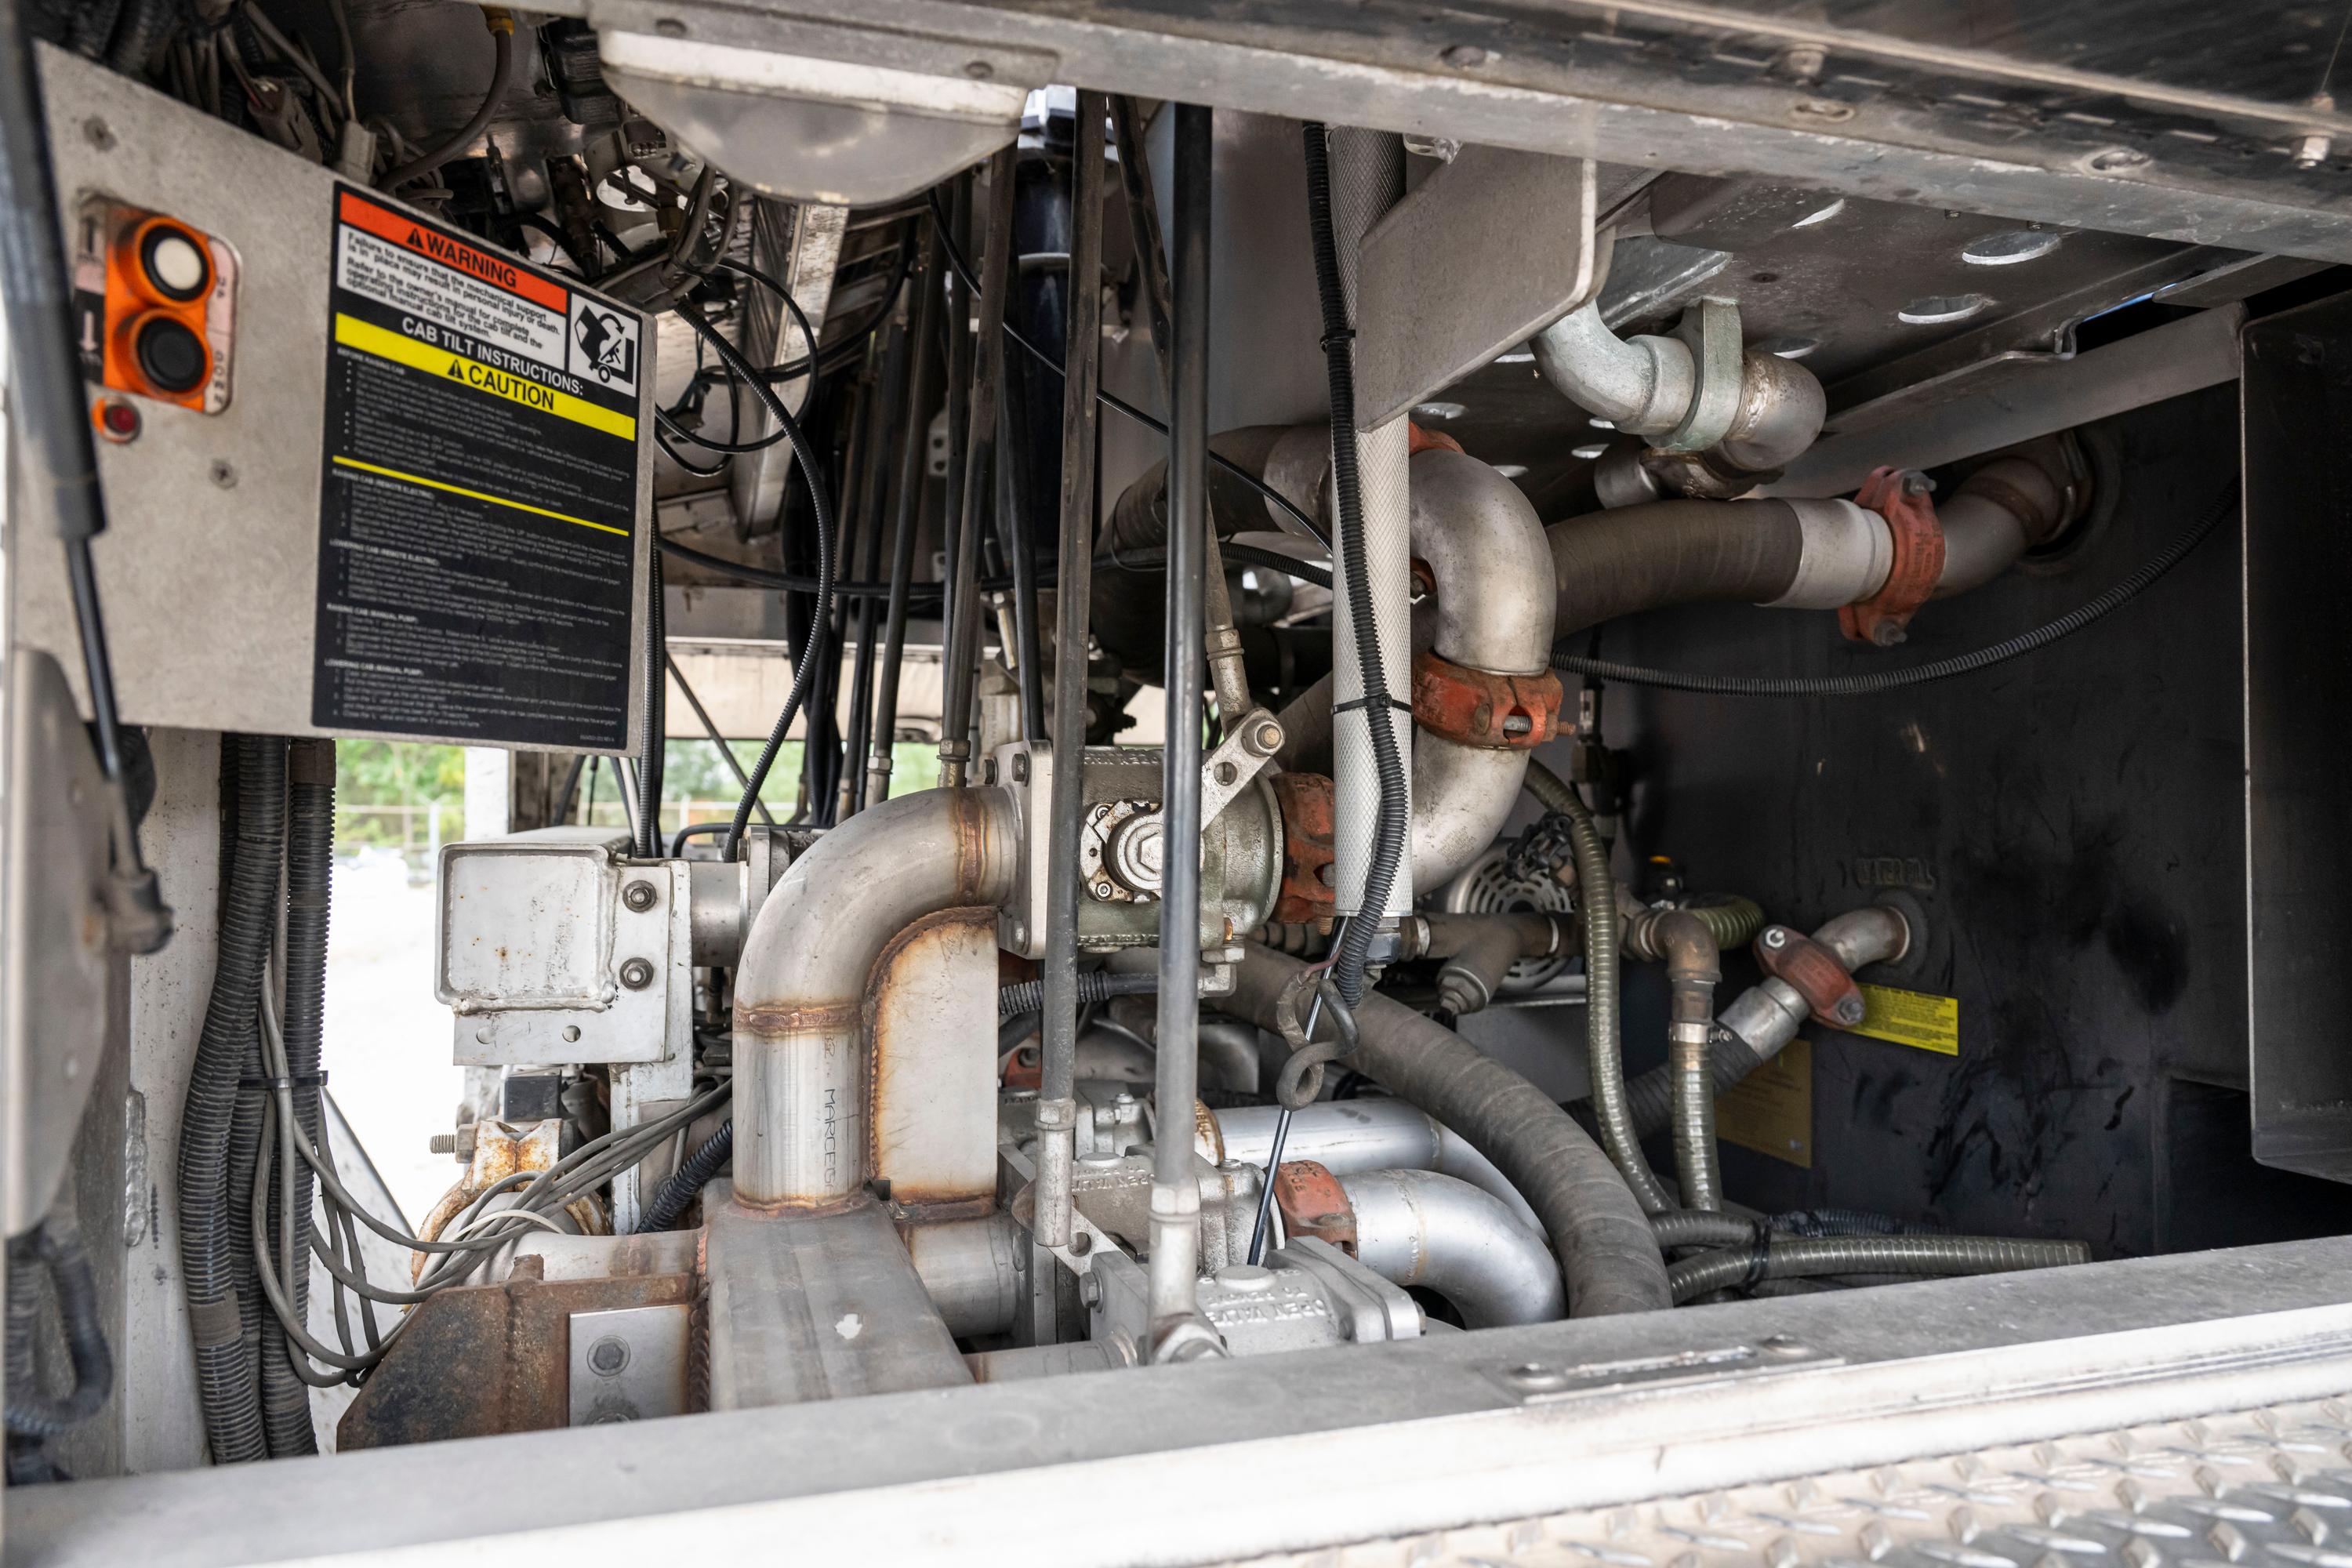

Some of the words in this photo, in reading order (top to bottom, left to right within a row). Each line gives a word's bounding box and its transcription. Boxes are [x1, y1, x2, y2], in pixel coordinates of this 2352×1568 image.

[347, 243, 355, 252] is
[360, 248, 368, 258] in
[374, 253, 399, 271] place
[402, 266, 421, 281] may
[424, 274, 449, 290] result
[452, 285, 460, 295] in
[463, 289, 499, 311] personal
[502, 305, 524, 322] injury
[527, 315, 535, 324] or
[537, 318, 560, 335] death.
[347, 256, 373, 274] Refer
[376, 269, 386, 279] to
[389, 273, 403, 286] the
[406, 280, 441, 301] owner's
[445, 295, 476, 315] manual
[479, 308, 490, 321] for
[492, 314, 529, 337] complete
[348, 231, 381, 253] Failure
[385, 247, 394, 259] to
[397, 253, 428, 273] ensure
[431, 267, 448, 281] that
[451, 274, 463, 287] the
[466, 281, 514, 307] mechanical
[516, 302, 546, 321] support
[426, 233, 516, 289] WARNING
[346, 276, 386, 299] optional
[390, 292, 423, 311] manual
[426, 306, 441, 318] cab
[445, 313, 455, 324] tilt
[459, 318, 490, 339] system.
[347, 267, 393, 293] operating
[396, 286, 449, 313] instructions
[454, 308, 464, 318] for
[467, 314, 481, 325] the
[484, 320, 498, 332] cab
[500, 326, 510, 337] tilt
[513, 331, 527, 343] and
[530, 337, 542, 349] the
[401, 315, 437, 344] CAB
[441, 330, 474, 357] TILT
[477, 343, 583, 396] INSTRUCTIONS:
[468, 363, 554, 411] CAUTION
